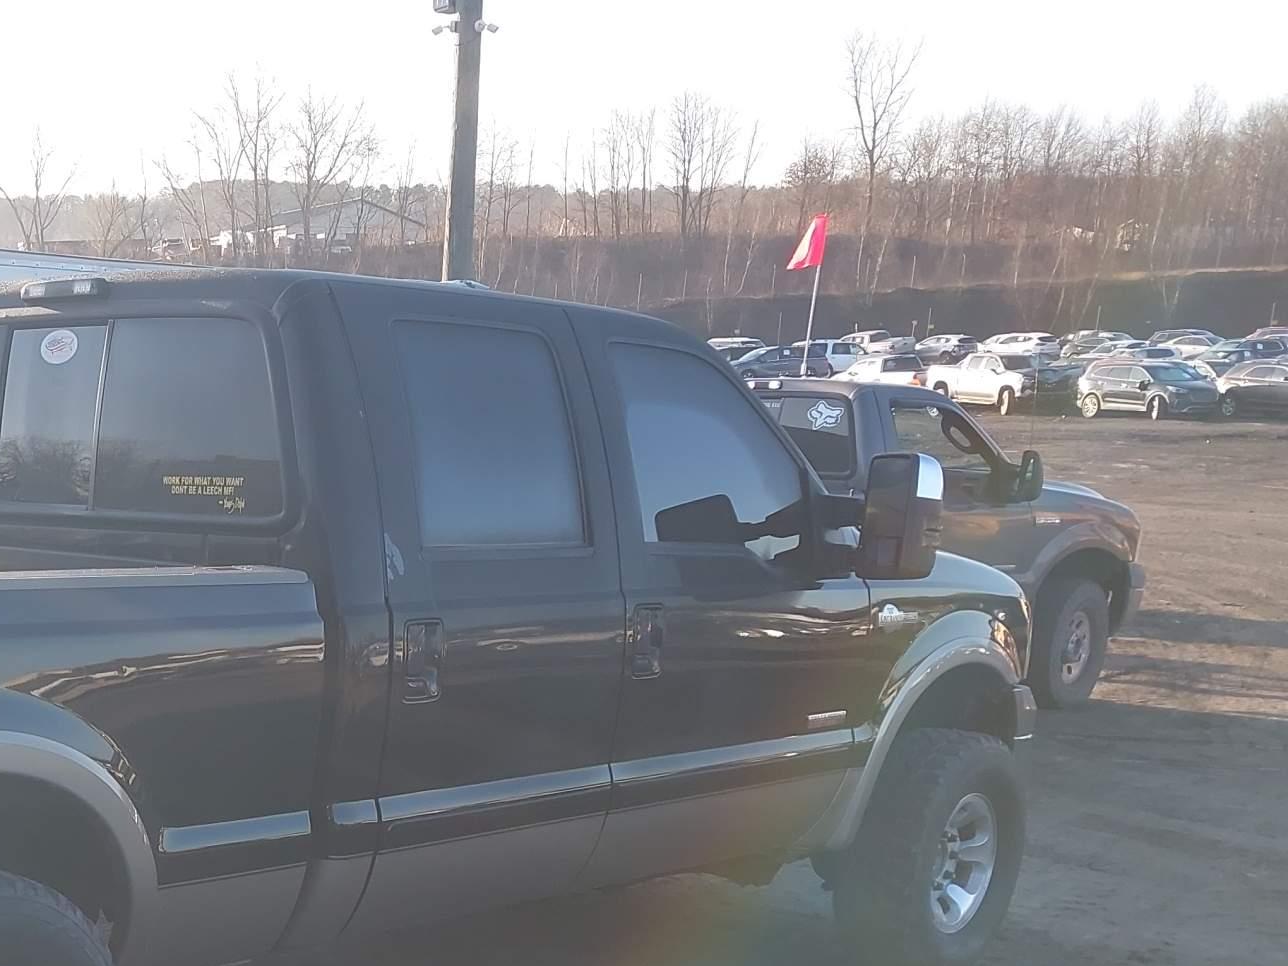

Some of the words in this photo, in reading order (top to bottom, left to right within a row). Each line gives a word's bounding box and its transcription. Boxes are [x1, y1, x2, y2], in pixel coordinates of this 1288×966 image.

[162, 476, 180, 485] WORK
[181, 476, 193, 485] FOR
[194, 476, 211, 486] WHAT
[213, 477, 225, 486] YOU
[226, 477, 244, 487] WANT
[188, 486, 197, 495] BE
[198, 486, 202, 495] A
[203, 486, 223, 495] LEECH
